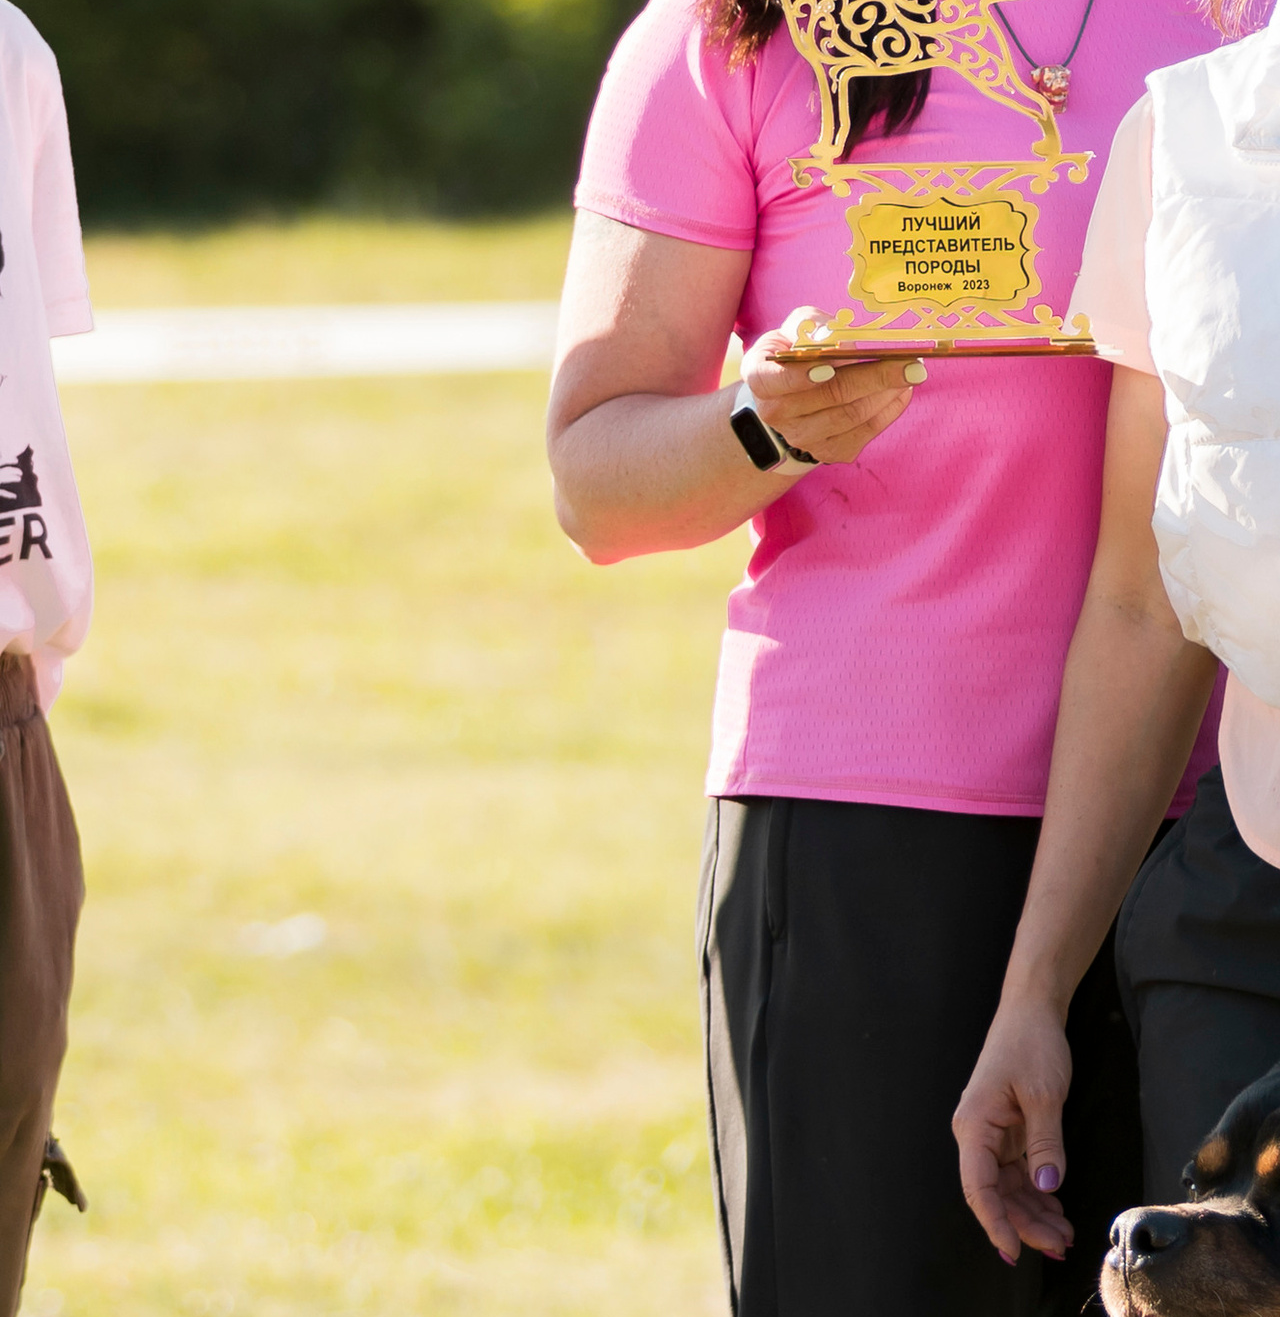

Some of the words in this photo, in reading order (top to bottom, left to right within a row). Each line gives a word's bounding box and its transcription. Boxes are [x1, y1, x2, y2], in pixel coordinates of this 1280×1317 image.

[901, 212, 981, 232] ЛУЧШИЙ
[869, 236, 1015, 256] ПРЕДСТАВИТЕЛЬ
[905, 259, 980, 276] ПОРОДЫ
[898, 281, 952, 293] Воронеж
[962, 279, 990, 291] 2023
